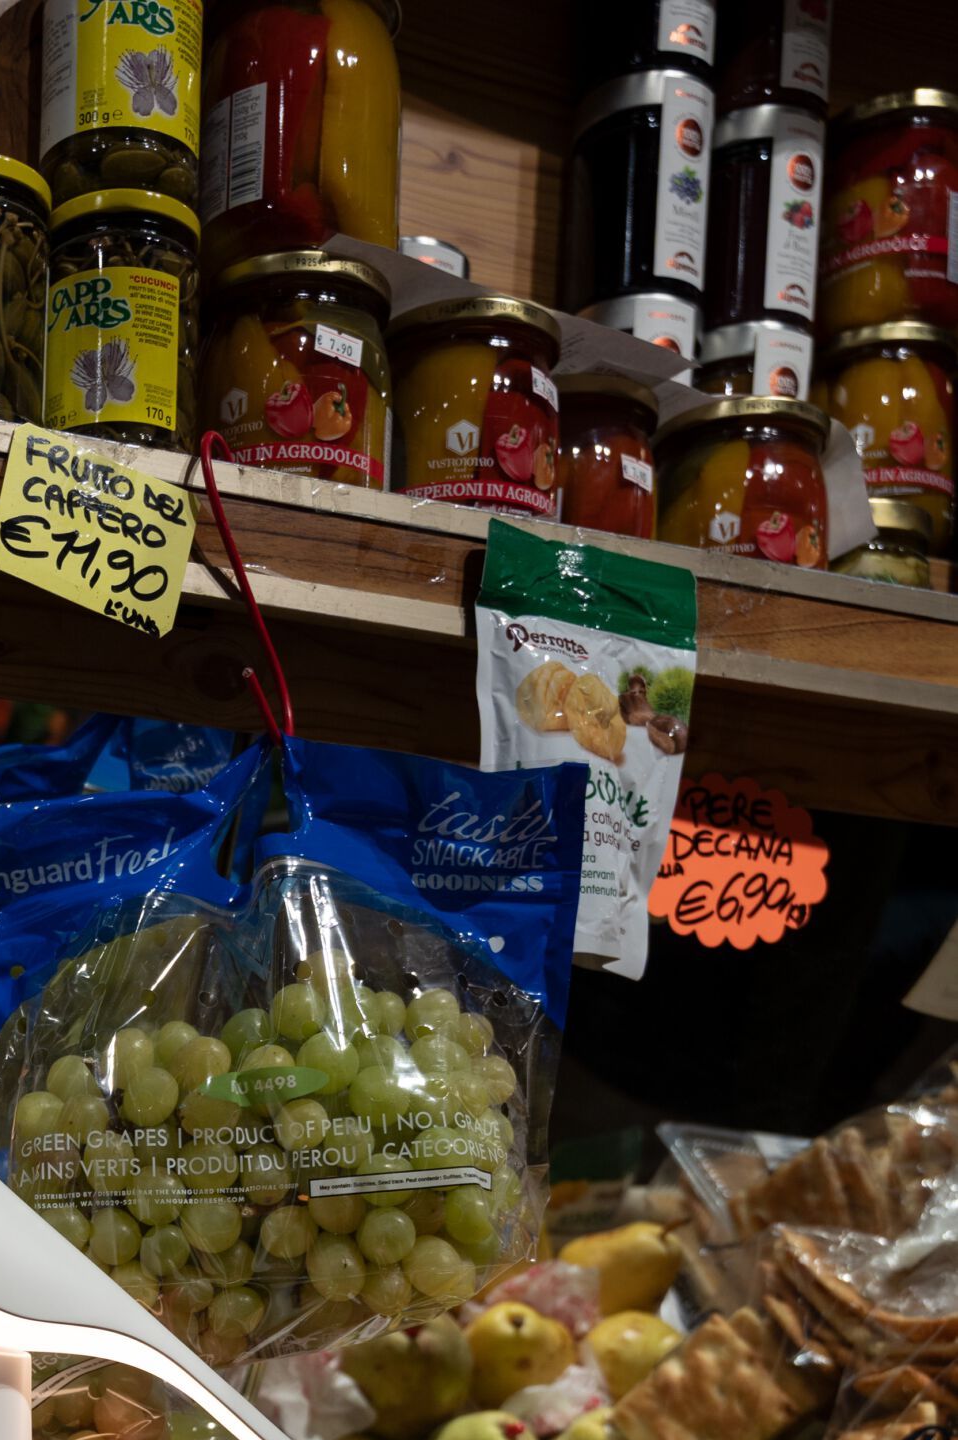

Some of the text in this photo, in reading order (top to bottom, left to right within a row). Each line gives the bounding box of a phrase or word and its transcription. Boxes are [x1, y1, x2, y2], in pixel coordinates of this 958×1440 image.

[78, 111, 109, 126] 300 g
[329, 338, 353, 357] 7.90
[145, 406, 164, 421] 170
[256, 445, 273, 461] IN
[277, 445, 370, 471] AGRODOLCE
[25, 435, 187, 526] FRUTTO DEL
[406, 483, 503, 499] PEPERONI IN
[22, 476, 166, 548] CAPPERO
[505, 623, 588, 656] Perrotta
[682, 786, 775, 831] PERE
[411, 839, 547, 870] SNACKABLE
[669, 829, 794, 866] DECANA
[411, 873, 544, 893] GOODNESS
[254, 1074, 297, 1093] 4498
[21, 1131, 82, 1158] GREEN
[87, 1128, 169, 1149] GRAPES
[193, 1124, 283, 1147] PRODUCT
[292, 1119, 316, 1141] OF
[321, 1114, 372, 1138] PERU
[454, 1111, 500, 1139] GRADE
[80, 1156, 142, 1178] VERTS
[166, 1154, 254, 1178] PRODUIT
[258, 1152, 288, 1173] DU
[292, 1144, 358, 1170] PÉROU
[171, 1187, 216, 1196] VANGUARD
